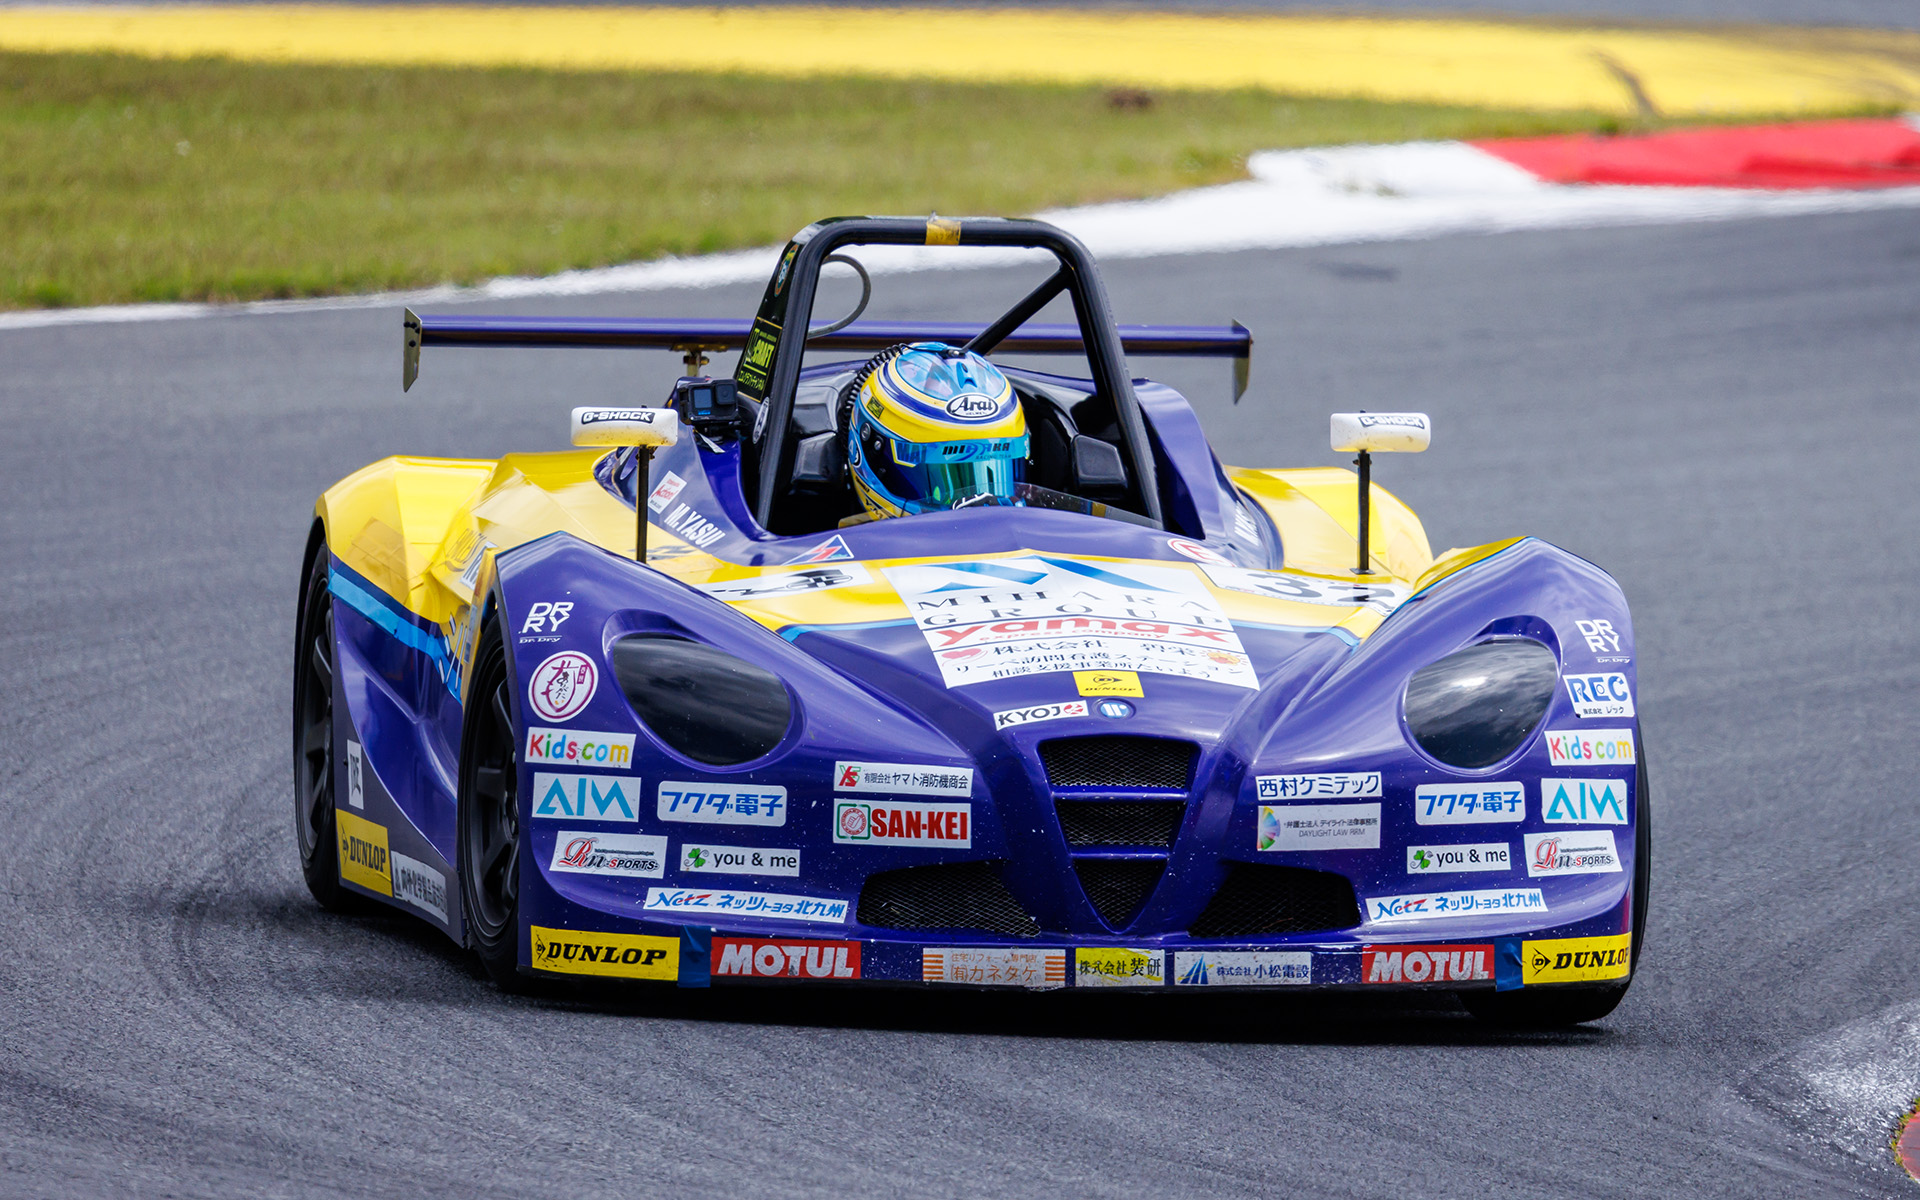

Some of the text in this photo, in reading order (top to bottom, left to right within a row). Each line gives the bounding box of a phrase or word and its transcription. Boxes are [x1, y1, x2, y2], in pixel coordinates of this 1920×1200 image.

[582, 412, 654, 424] G-SHOCK
[951, 396, 994, 414] Arai
[664, 502, 726, 548] M.YASUI
[917, 590, 1212, 612] MIHARA
[923, 603, 1223, 626] GROUP
[936, 618, 1229, 647] yamax
[1567, 676, 1628, 703] REC
[1259, 775, 1380, 797] 西村ケミテック
[661, 791, 783, 817] フクダ電子
[1418, 790, 1523, 816] フクダ電子
[1299, 829, 1332, 838] DAYLIGHT
[1333, 828, 1348, 836] LAW
[350, 836, 386, 873] DUNLOP
[714, 852, 798, 868] you & me
[1436, 850, 1508, 867] you & me
[648, 891, 846, 918] Netz ネッツトヨタ北九州
[1376, 891, 1542, 918] Netz ネッツトヨタ北九州
[547, 941, 667, 966] DUNLOP
[717, 943, 854, 978] MOTUL
[1368, 951, 1489, 982] MOTUL
